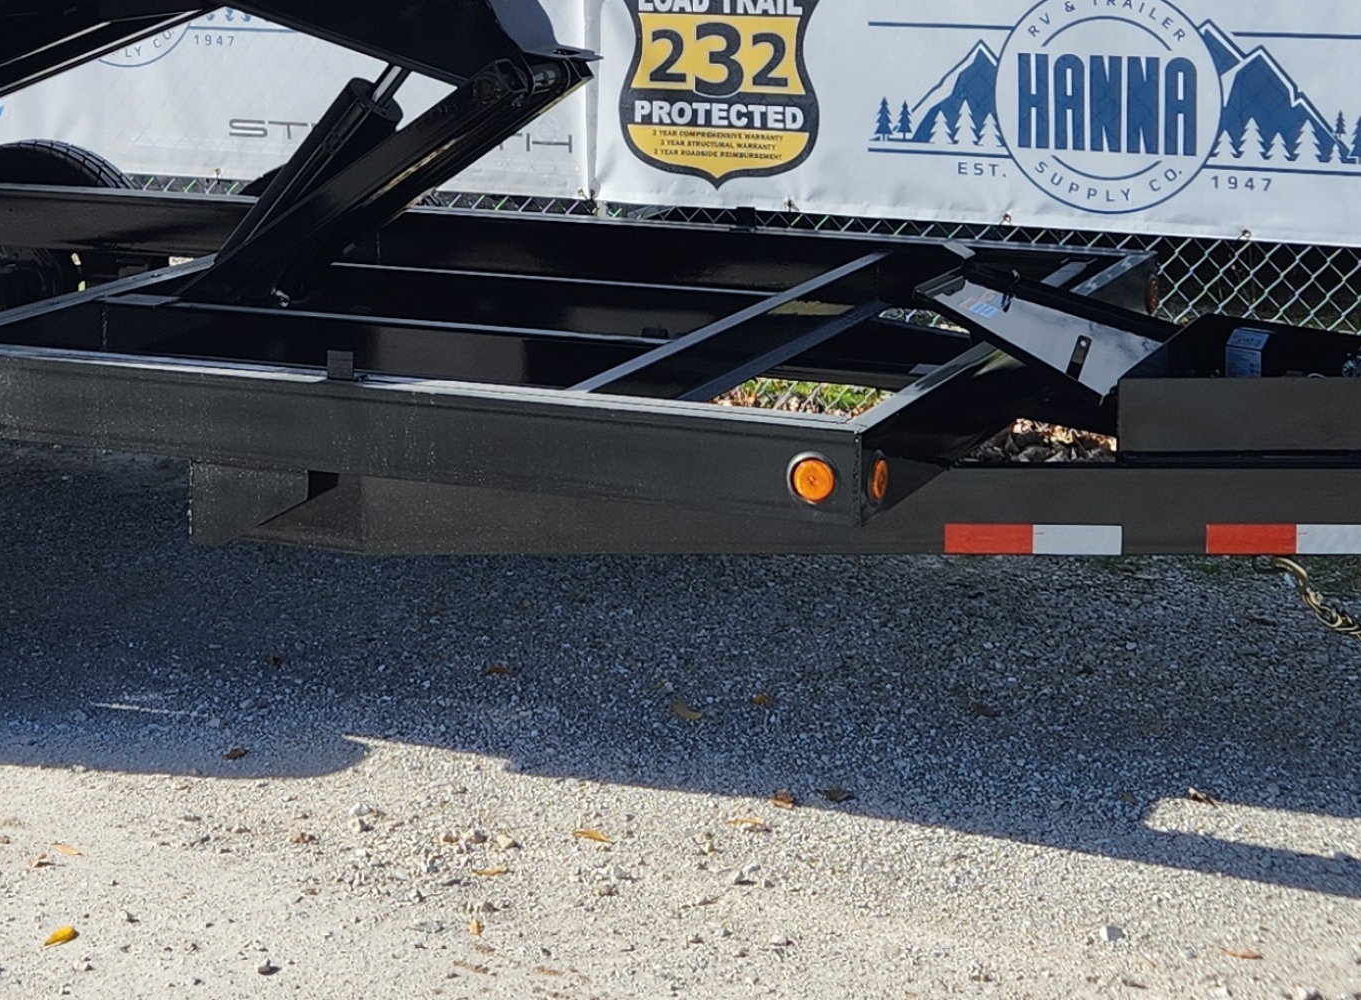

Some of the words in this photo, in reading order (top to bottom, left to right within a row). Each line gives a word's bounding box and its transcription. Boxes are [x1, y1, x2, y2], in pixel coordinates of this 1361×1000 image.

[1027, 12, 1052, 38] RV
[1064, 0, 1076, 13] &
[193, 34, 235, 47] 1947
[648, 21, 789, 98] 232
[1017, 52, 1198, 157] HANNA
[634, 100, 804, 129] PROTECTED
[658, 129, 678, 138] YEAR
[679, 130, 743, 140] COMPREHENSIVE
[744, 133, 784, 142] WARRANTY
[666, 139, 685, 147] YEAR
[687, 140, 734, 149] STRUCTURAL
[736, 142, 776, 151] WARRANTY
[660, 148, 679, 156] YEAR
[680, 149, 718, 158] ROADSIDE
[719, 151, 783, 160] REIMBURSEMENT
[957, 161, 1007, 178] EST.
[1034, 160, 1133, 202] SUPPLY
[1148, 168, 1183, 193] CO.
[1210, 175, 1273, 192] 1947
